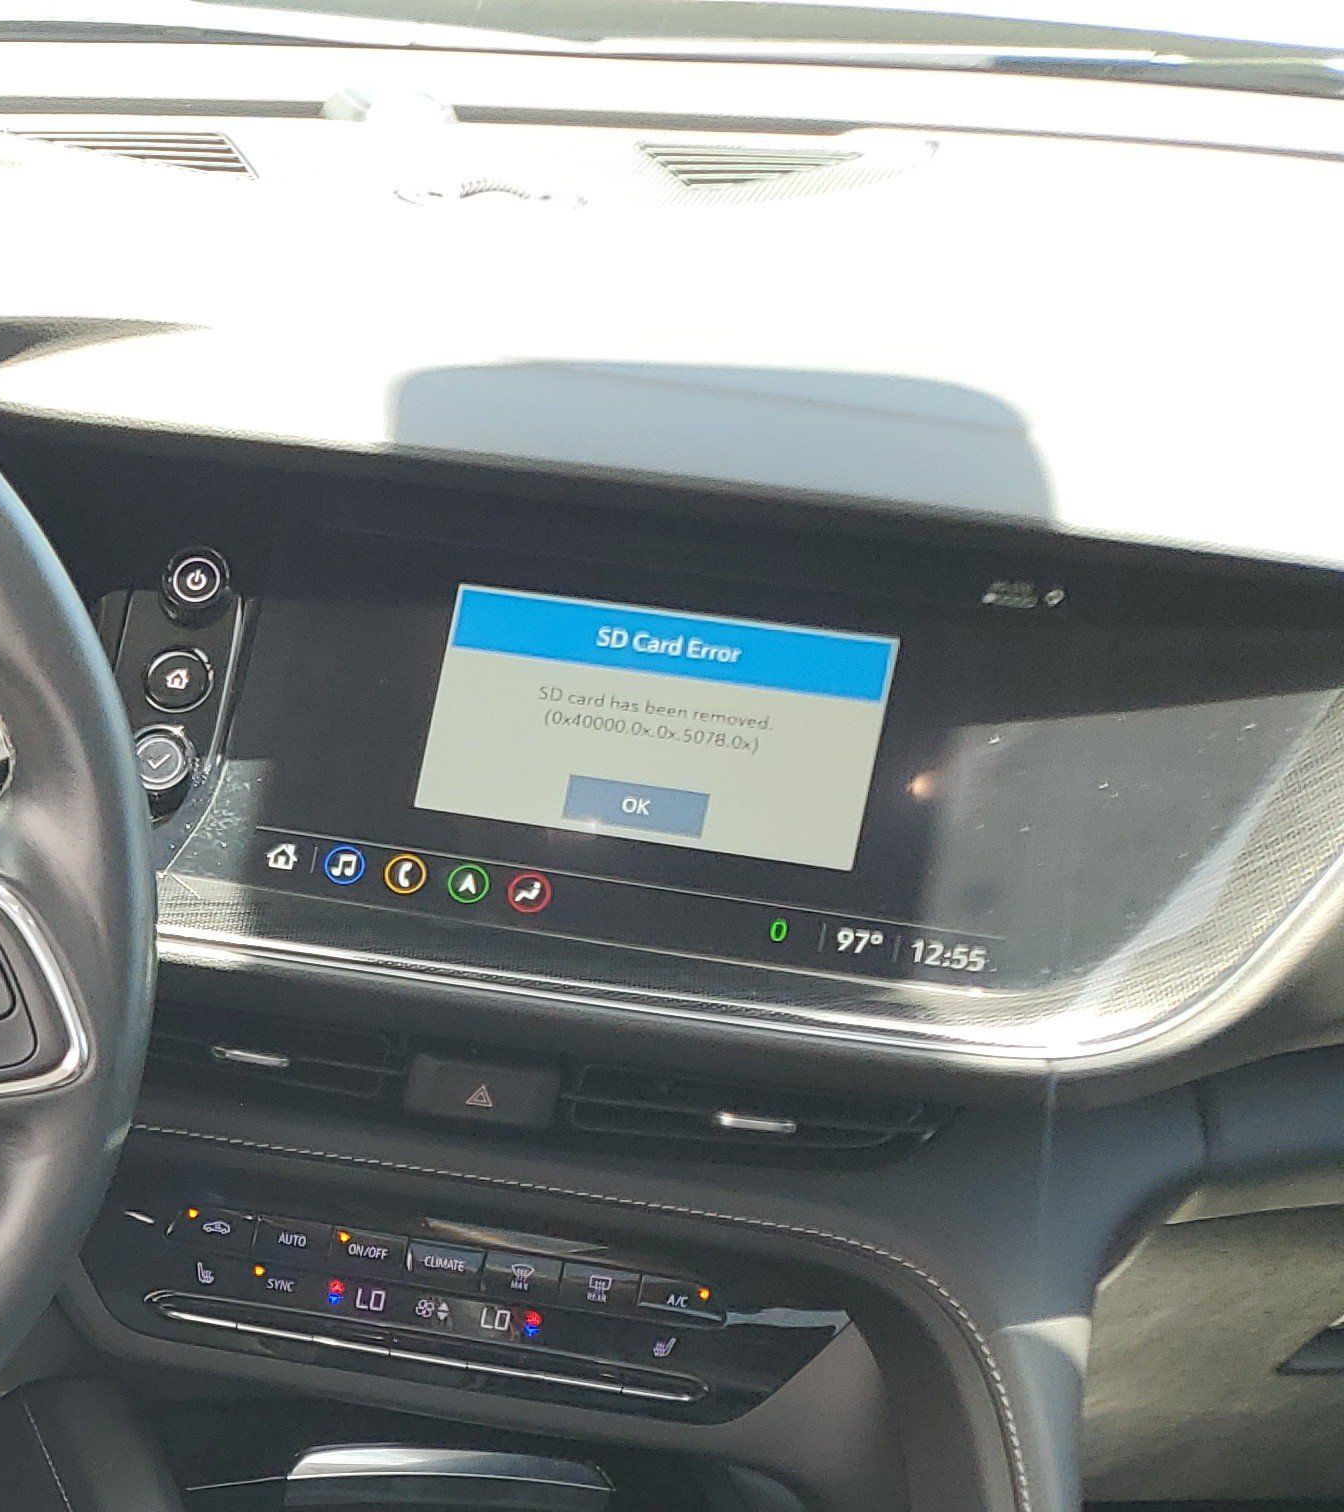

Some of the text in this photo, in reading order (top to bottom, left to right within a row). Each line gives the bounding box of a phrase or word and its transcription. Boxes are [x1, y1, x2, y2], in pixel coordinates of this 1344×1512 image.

[596, 626, 742, 663] SD Card Error
[538, 686, 774, 731] SD card has been removed.
[621, 796, 651, 816] OK
[770, 918, 788, 942] 0
[911, 939, 987, 972] 12:55
[277, 1231, 307, 1248] AUTO
[348, 1243, 389, 1260] ON/OFF
[423, 1255, 465, 1272] CLIMATE
[266, 1278, 295, 1293] SYNC
[355, 1288, 386, 1312] LO
[666, 1293, 688, 1308] A/C
[480, 1307, 511, 1331] LO
